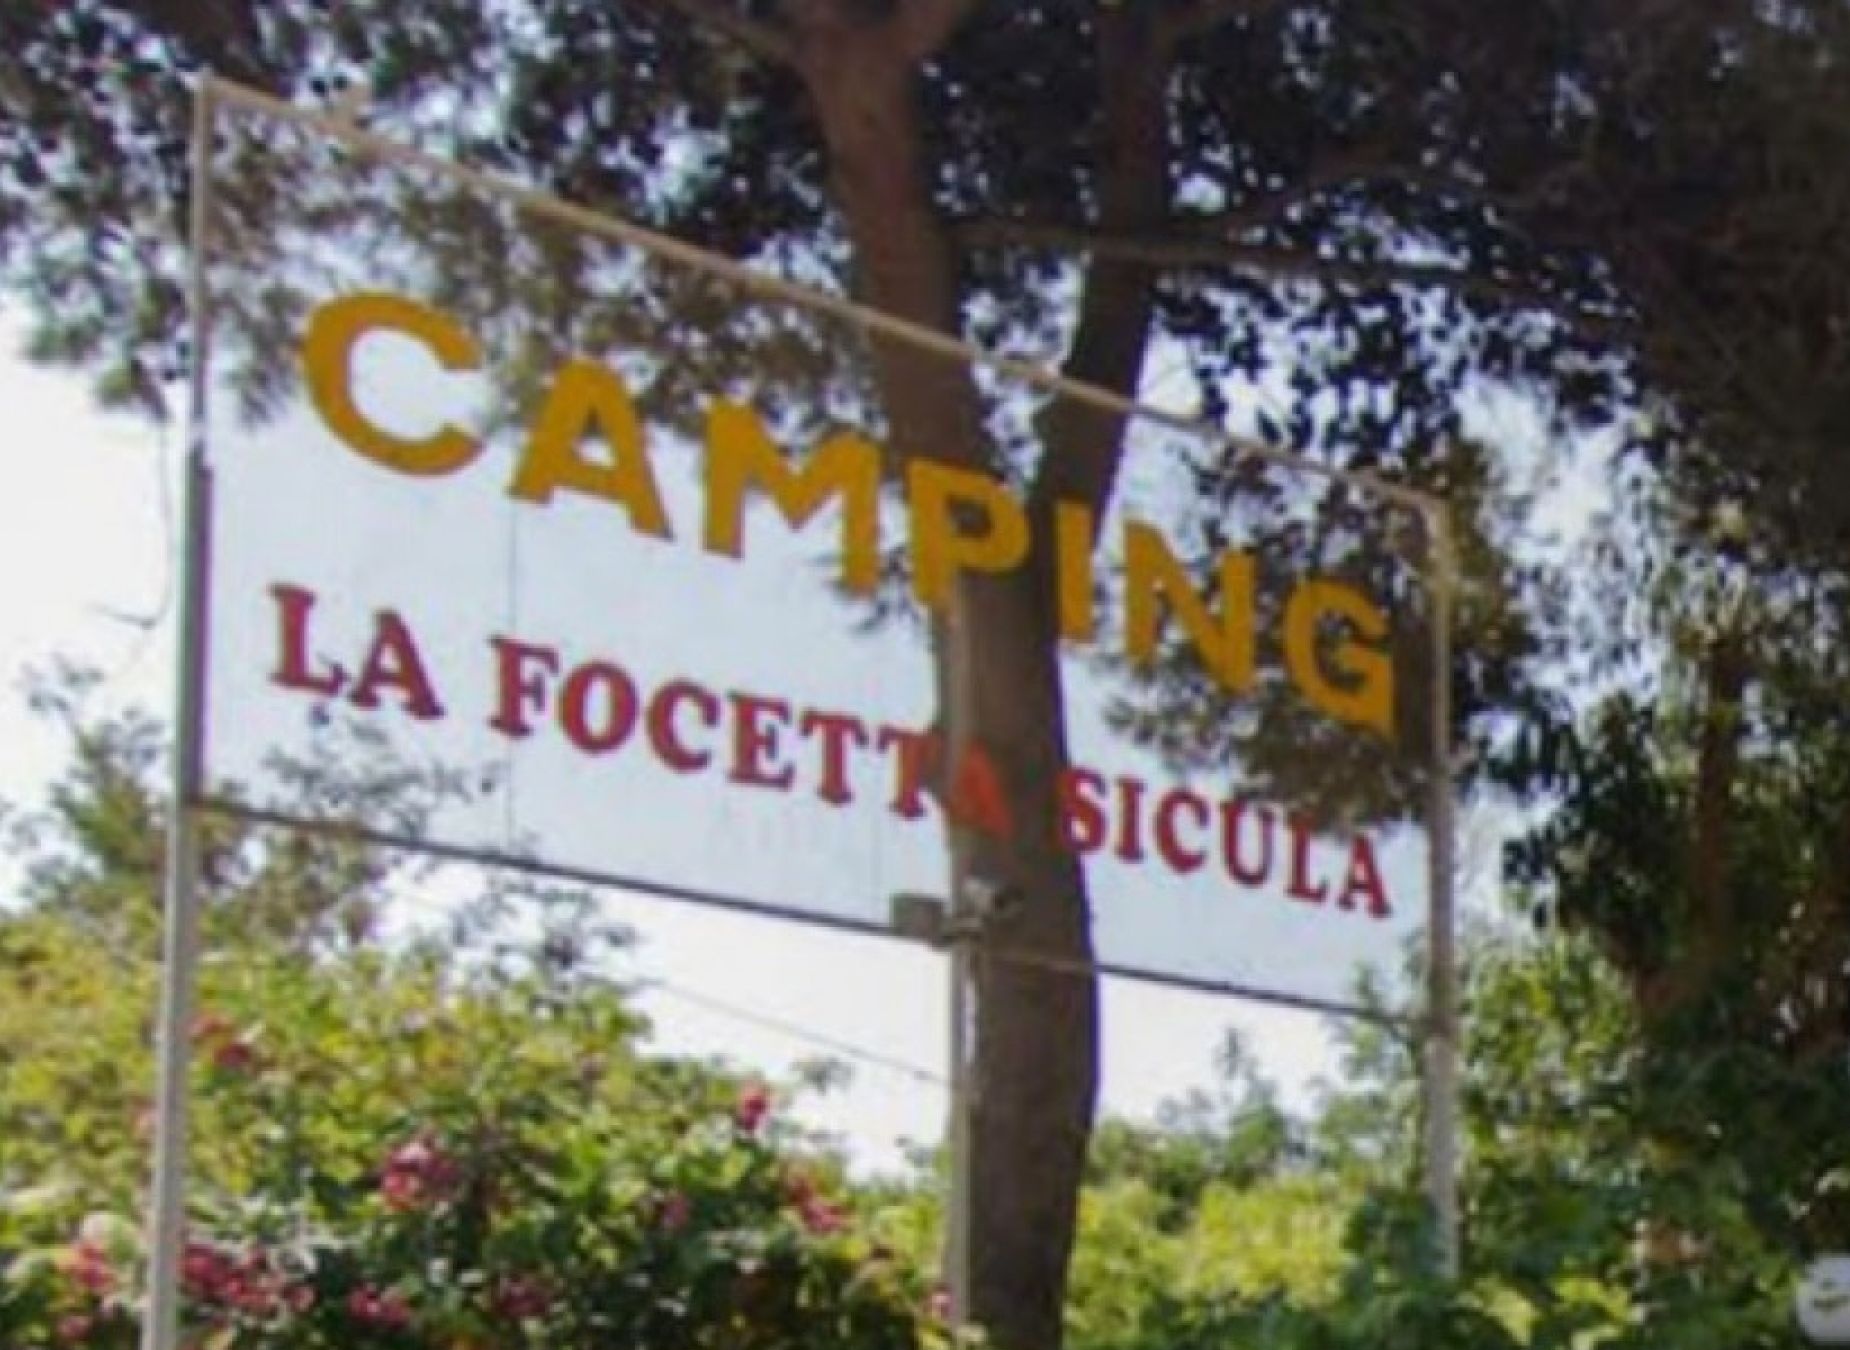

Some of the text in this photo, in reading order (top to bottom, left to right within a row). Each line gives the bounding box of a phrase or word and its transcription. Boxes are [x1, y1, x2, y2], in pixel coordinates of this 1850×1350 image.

[302, 289, 1396, 736] CAMPING
[269, 583, 1392, 919] LA FOCETTA SICULA
